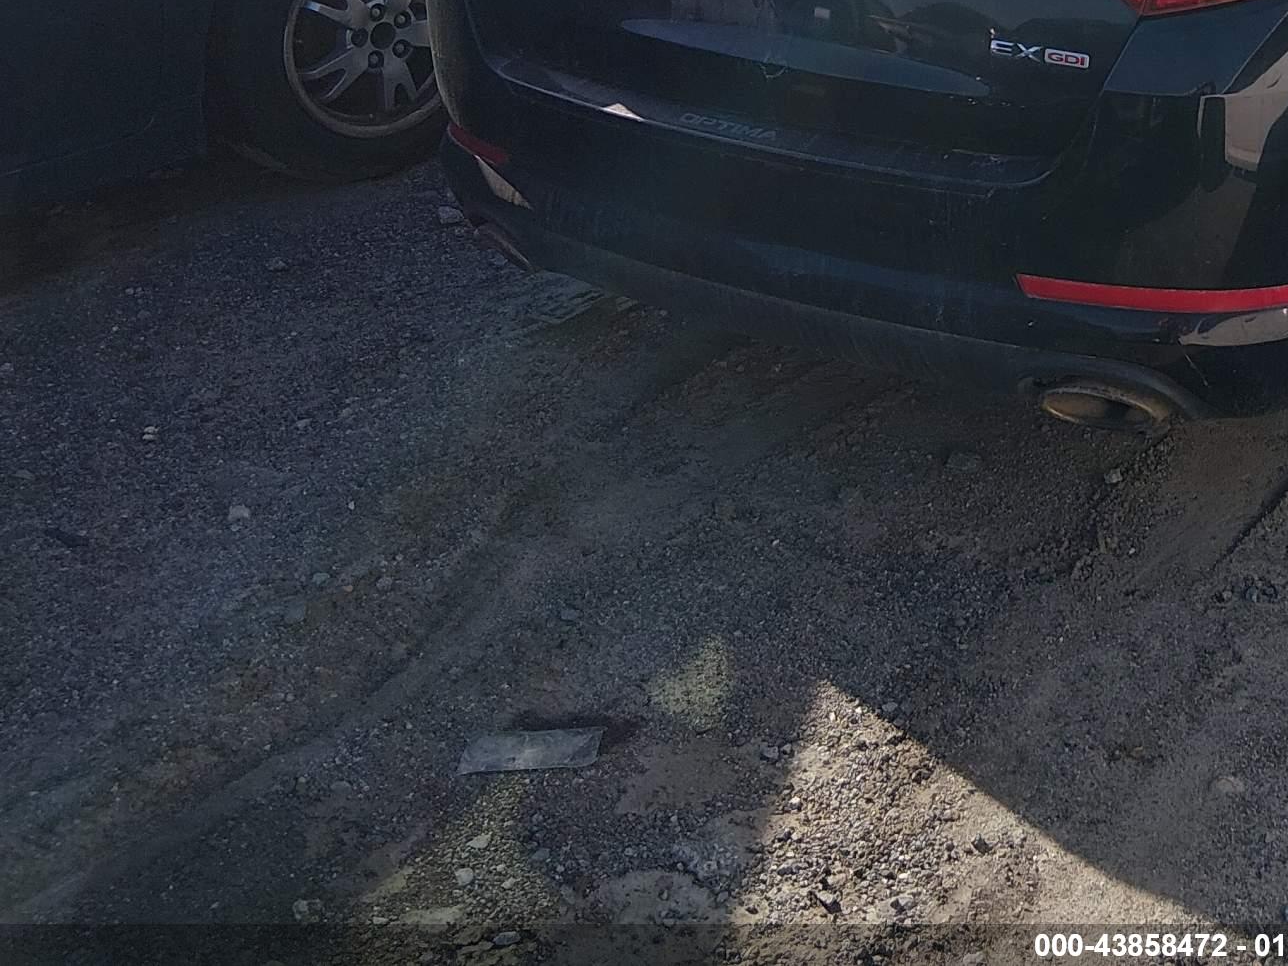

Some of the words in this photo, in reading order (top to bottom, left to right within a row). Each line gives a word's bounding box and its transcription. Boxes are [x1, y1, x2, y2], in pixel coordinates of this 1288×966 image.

[990, 39, 1043, 63] EX
[1047, 52, 1086, 66] GDI
[679, 113, 777, 141] OPTIMA
